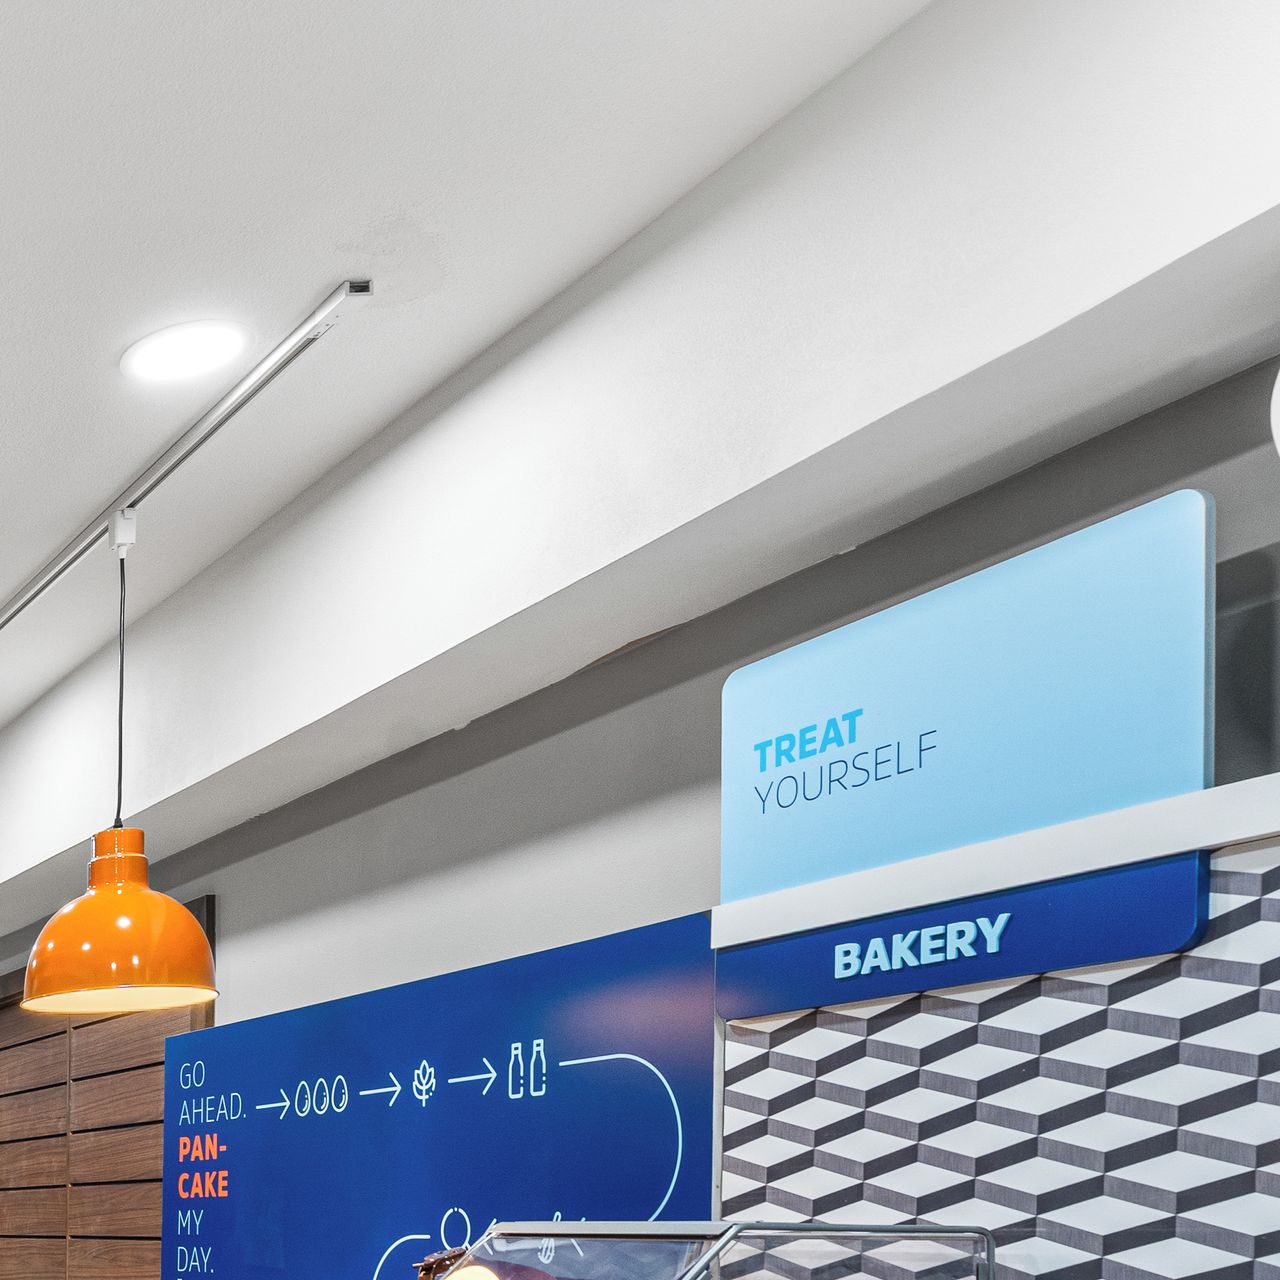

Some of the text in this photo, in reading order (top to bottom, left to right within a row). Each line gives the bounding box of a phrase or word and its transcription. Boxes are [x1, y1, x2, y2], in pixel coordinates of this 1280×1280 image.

[753, 708, 863, 773] TREAT
[753, 729, 938, 815] YOURSELF
[834, 912, 1012, 980] BAKERY
[179, 1060, 206, 1089] GO
[178, 1092, 247, 1126] AHEAD.
[178, 1132, 227, 1163] PAN-
[177, 1170, 229, 1200] CAKE
[177, 1209, 204, 1236] MY
[177, 1246, 214, 1273] DAY.
